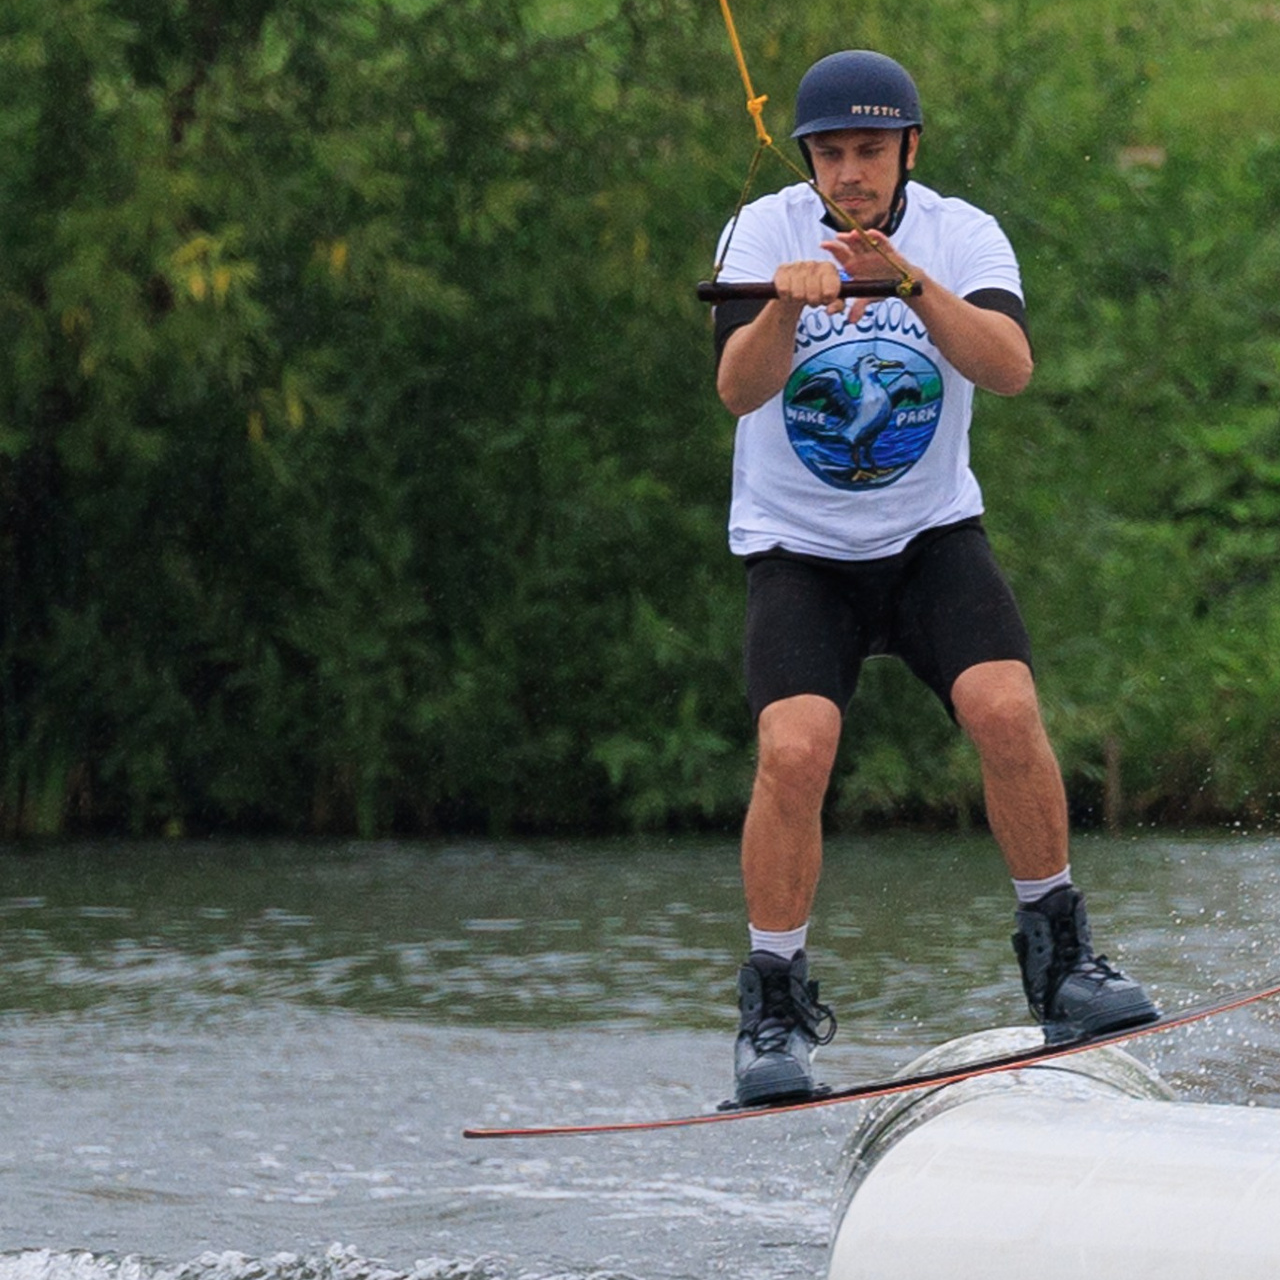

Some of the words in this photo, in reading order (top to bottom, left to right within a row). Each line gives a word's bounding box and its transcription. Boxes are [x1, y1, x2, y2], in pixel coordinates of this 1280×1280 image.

[851, 105, 900, 117] MYSTIC
[785, 406, 826, 424] WAKE
[896, 405, 937, 427] PARK
